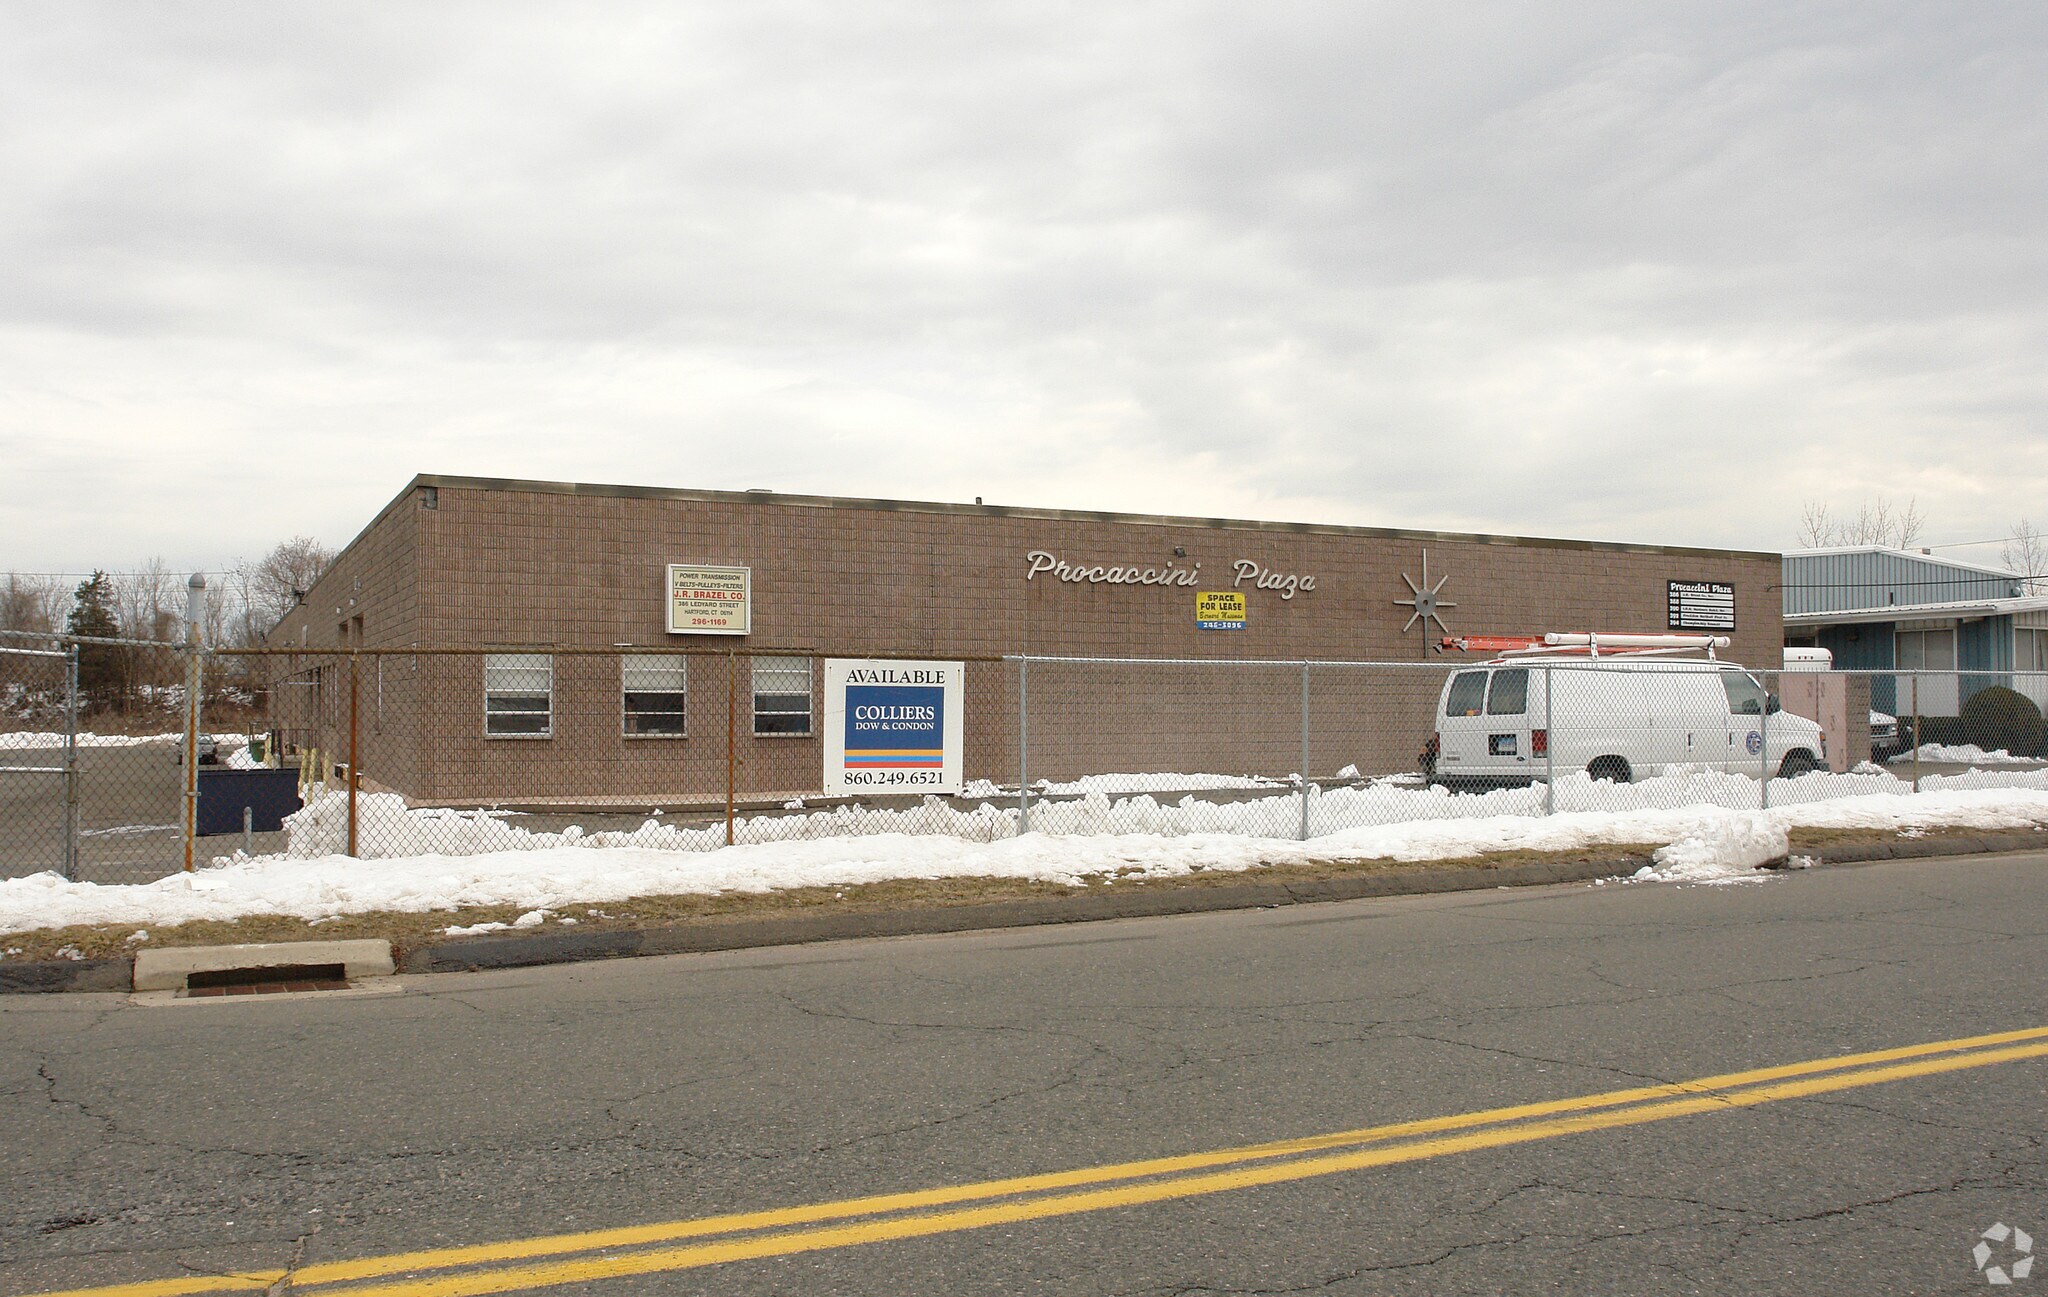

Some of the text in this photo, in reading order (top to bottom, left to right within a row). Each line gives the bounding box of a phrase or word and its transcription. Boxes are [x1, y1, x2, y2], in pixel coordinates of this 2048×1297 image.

[1026, 550, 1316, 600] Procaccini Plaza
[1712, 585, 1732, 593] Plaza
[674, 590, 746, 600] J.R. BRAZEL CO.
[1207, 594, 1235, 602] SPACE
[1200, 602, 1242, 611] FOR LEASE
[846, 669, 946, 684] AVAILABLE
[855, 706, 935, 720] COLLIERS
[855, 722, 935, 730] DOW & CONDON
[844, 771, 944, 785] 860.249.6521
